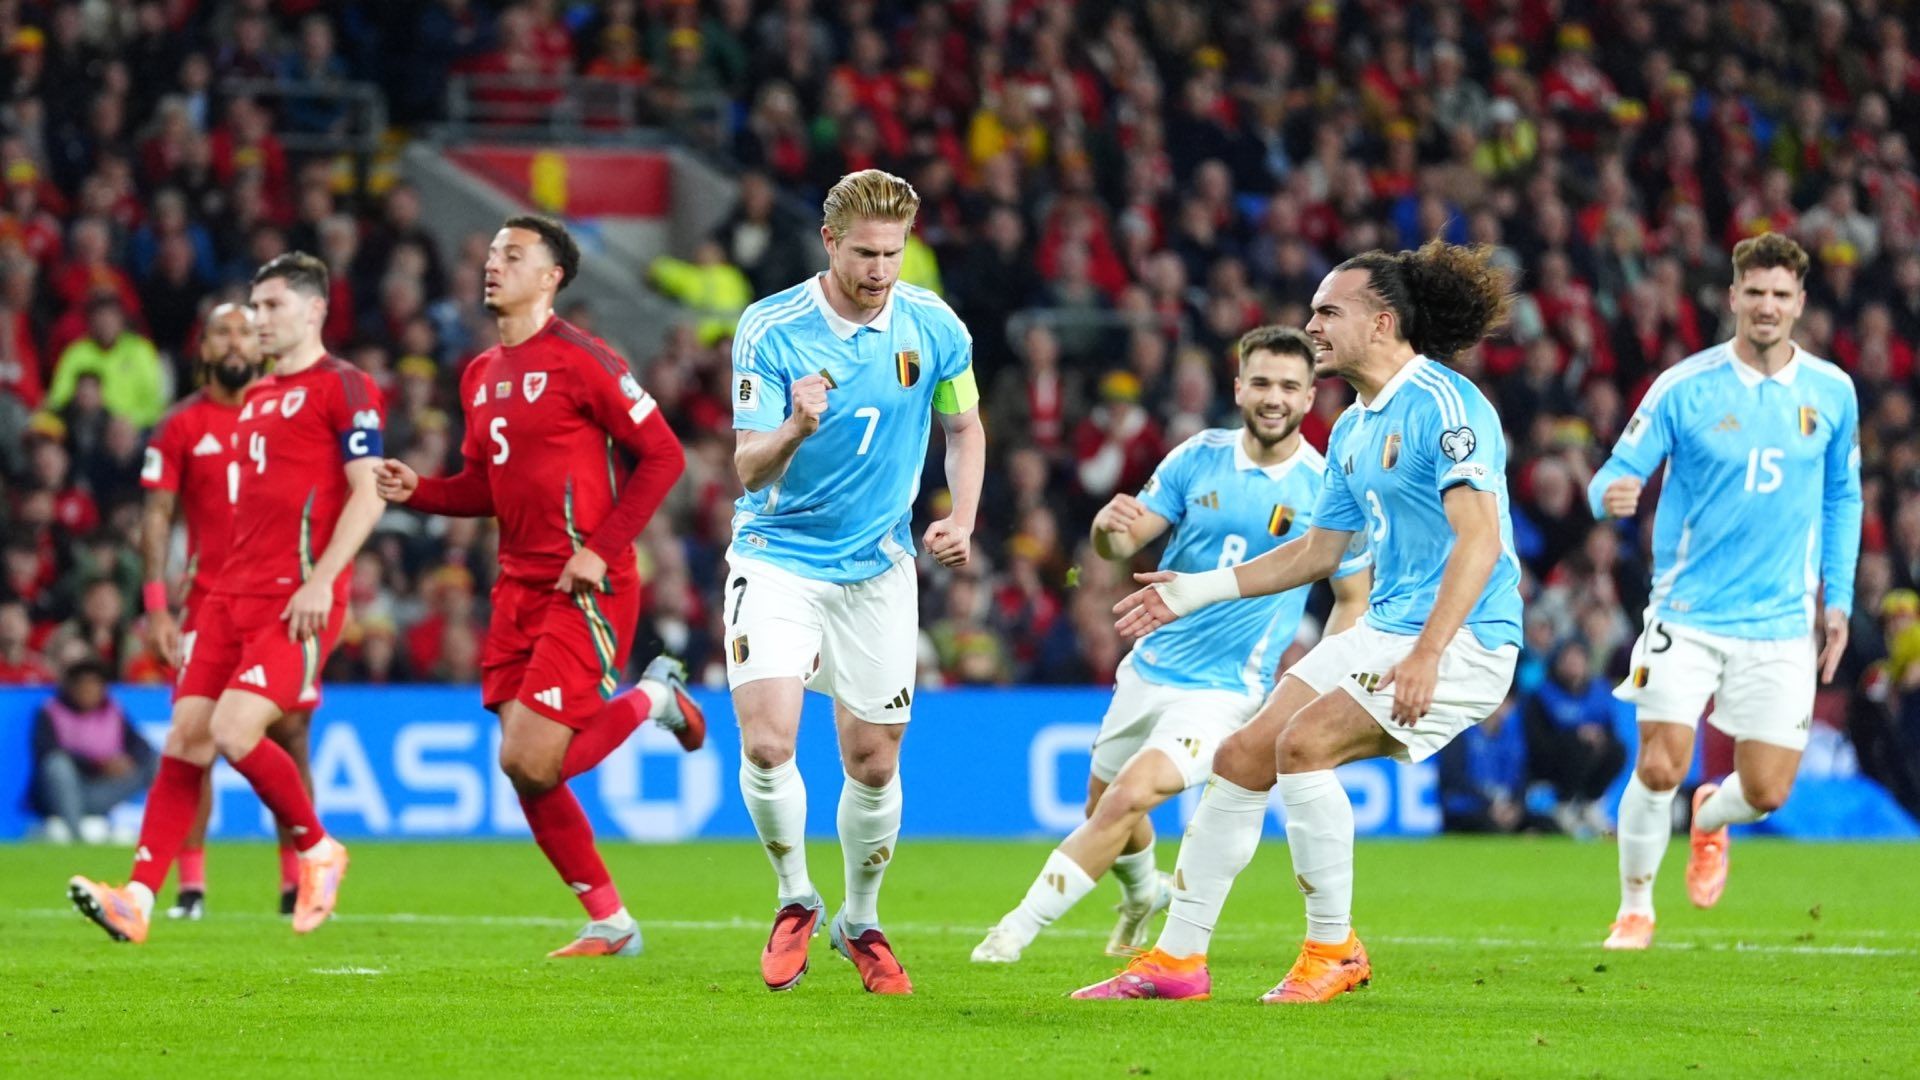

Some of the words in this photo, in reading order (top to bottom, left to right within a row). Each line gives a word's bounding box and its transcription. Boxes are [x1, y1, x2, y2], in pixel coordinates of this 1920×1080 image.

[249, 431, 266, 475] 4
[349, 431, 369, 455] C
[490, 416, 510, 465] 5
[854, 406, 881, 455] 7
[1744, 447, 1786, 494] 15
[1365, 489, 1387, 542] 3
[1217, 533, 1248, 569] 8
[732, 576, 748, 626] 7
